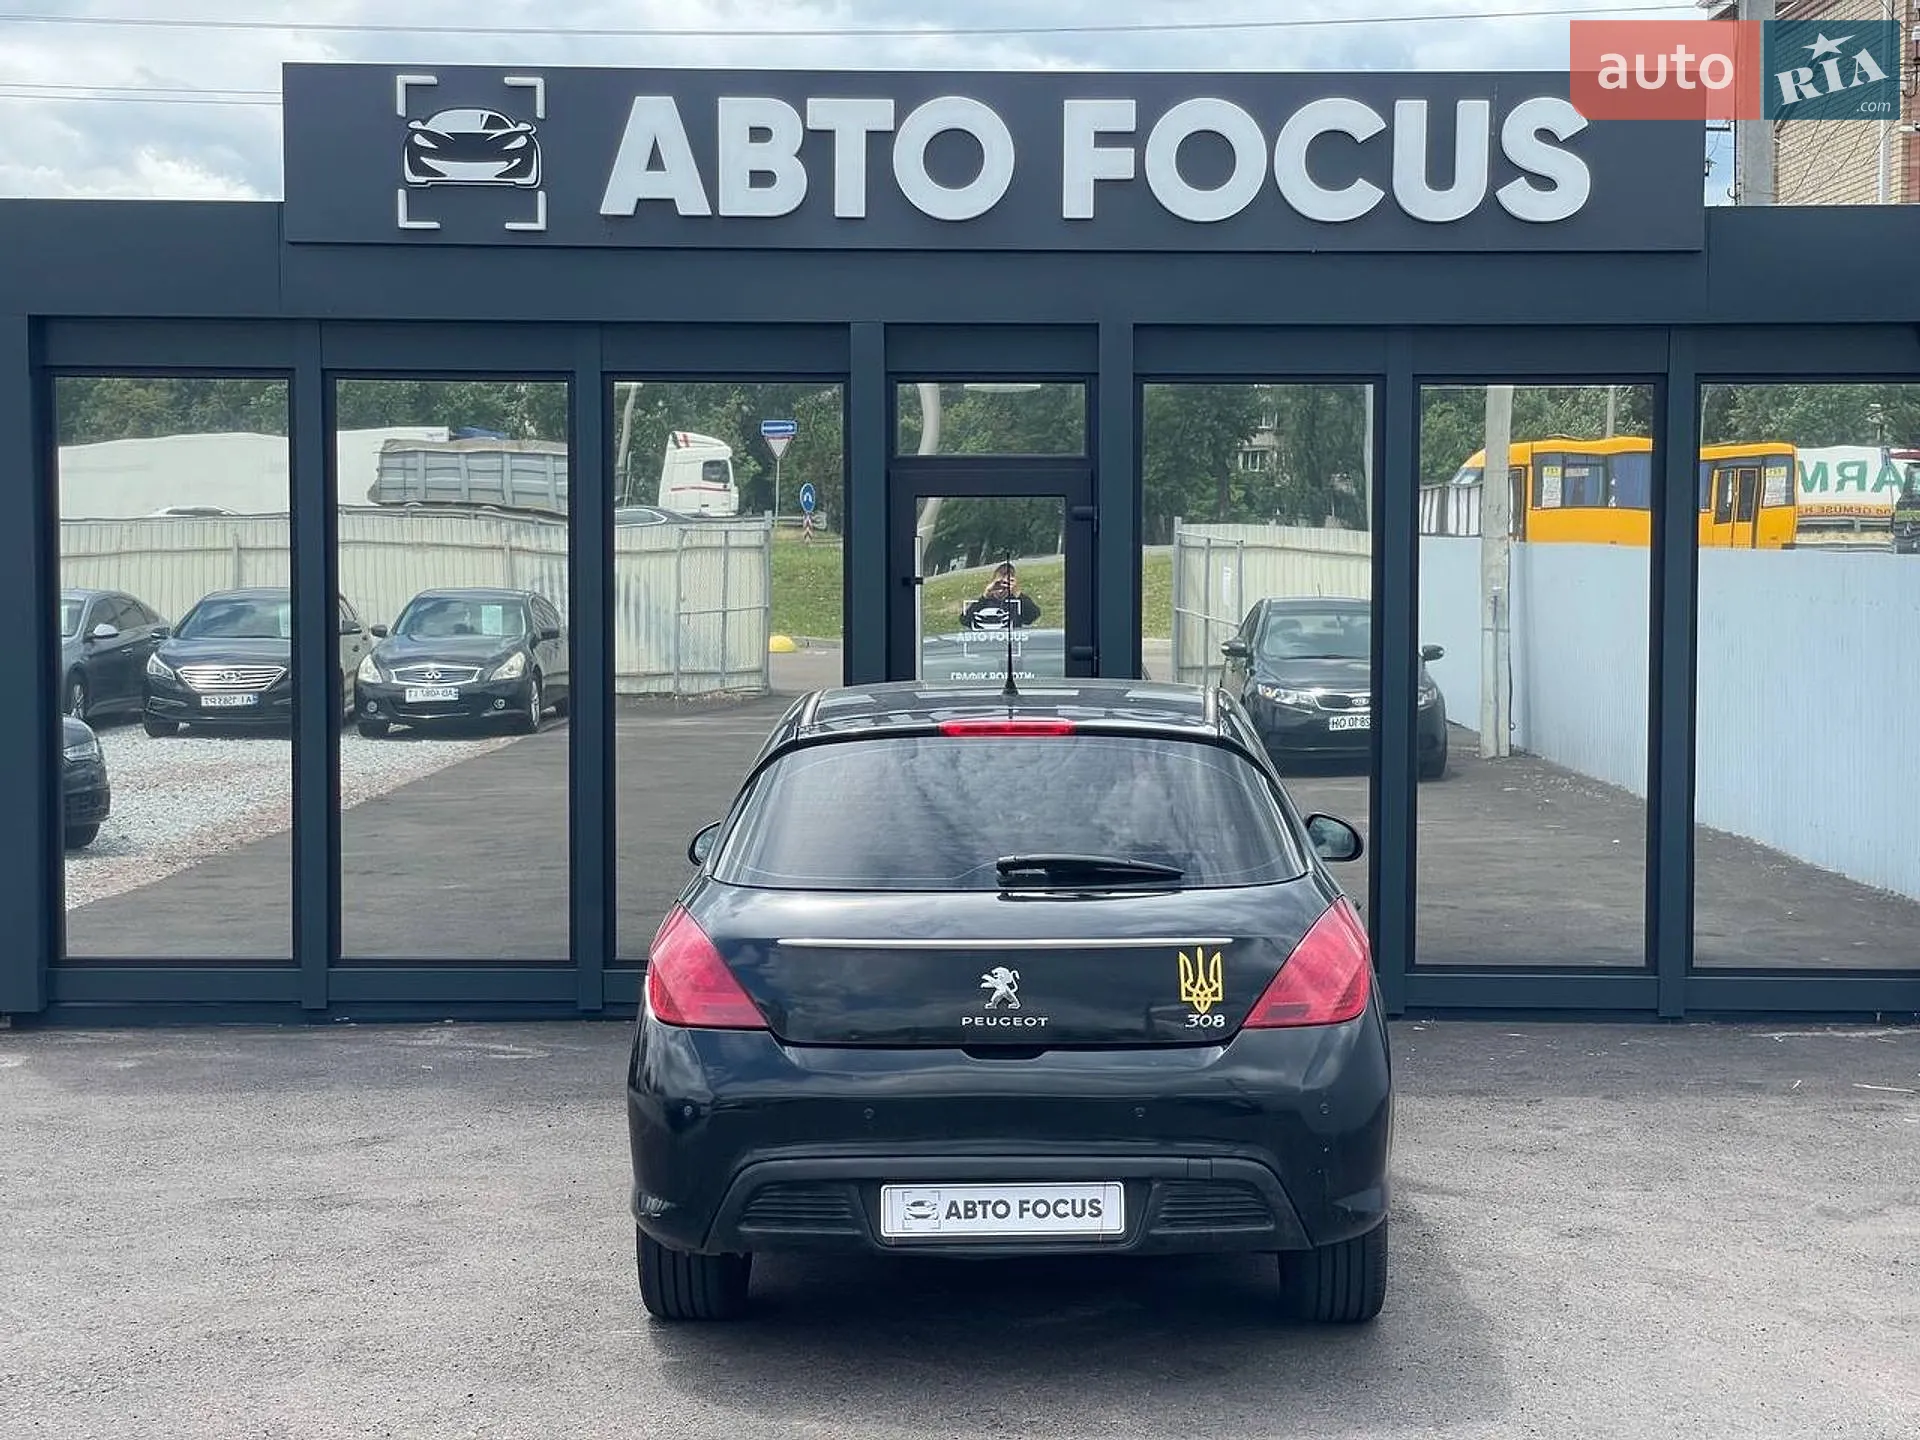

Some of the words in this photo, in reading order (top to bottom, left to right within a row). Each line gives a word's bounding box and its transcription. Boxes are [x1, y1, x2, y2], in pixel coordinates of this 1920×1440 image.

[599, 94, 1016, 222] АВТО
[1063, 97, 1591, 223] FOCUS
[961, 1016, 1049, 1027] PEUGEOT
[1184, 1014, 1226, 1028] 308
[945, 1199, 1011, 1220] АВТО
[1018, 1198, 1103, 1219] FOCUS
